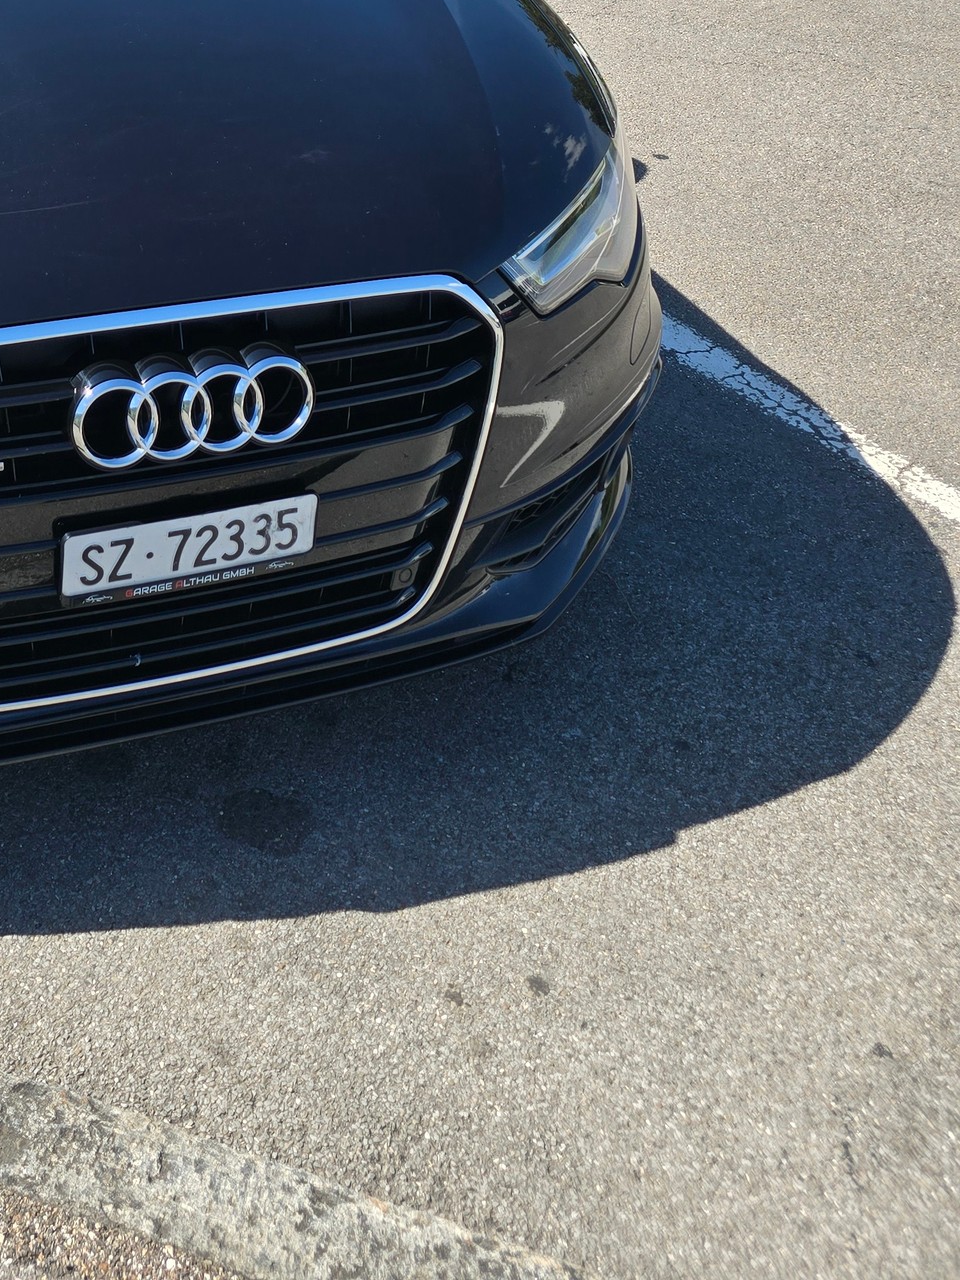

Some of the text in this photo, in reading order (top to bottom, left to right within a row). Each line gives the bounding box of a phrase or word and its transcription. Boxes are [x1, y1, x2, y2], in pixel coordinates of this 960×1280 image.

[125, 566, 255, 598] GARAGE ALTHAU GMBH
